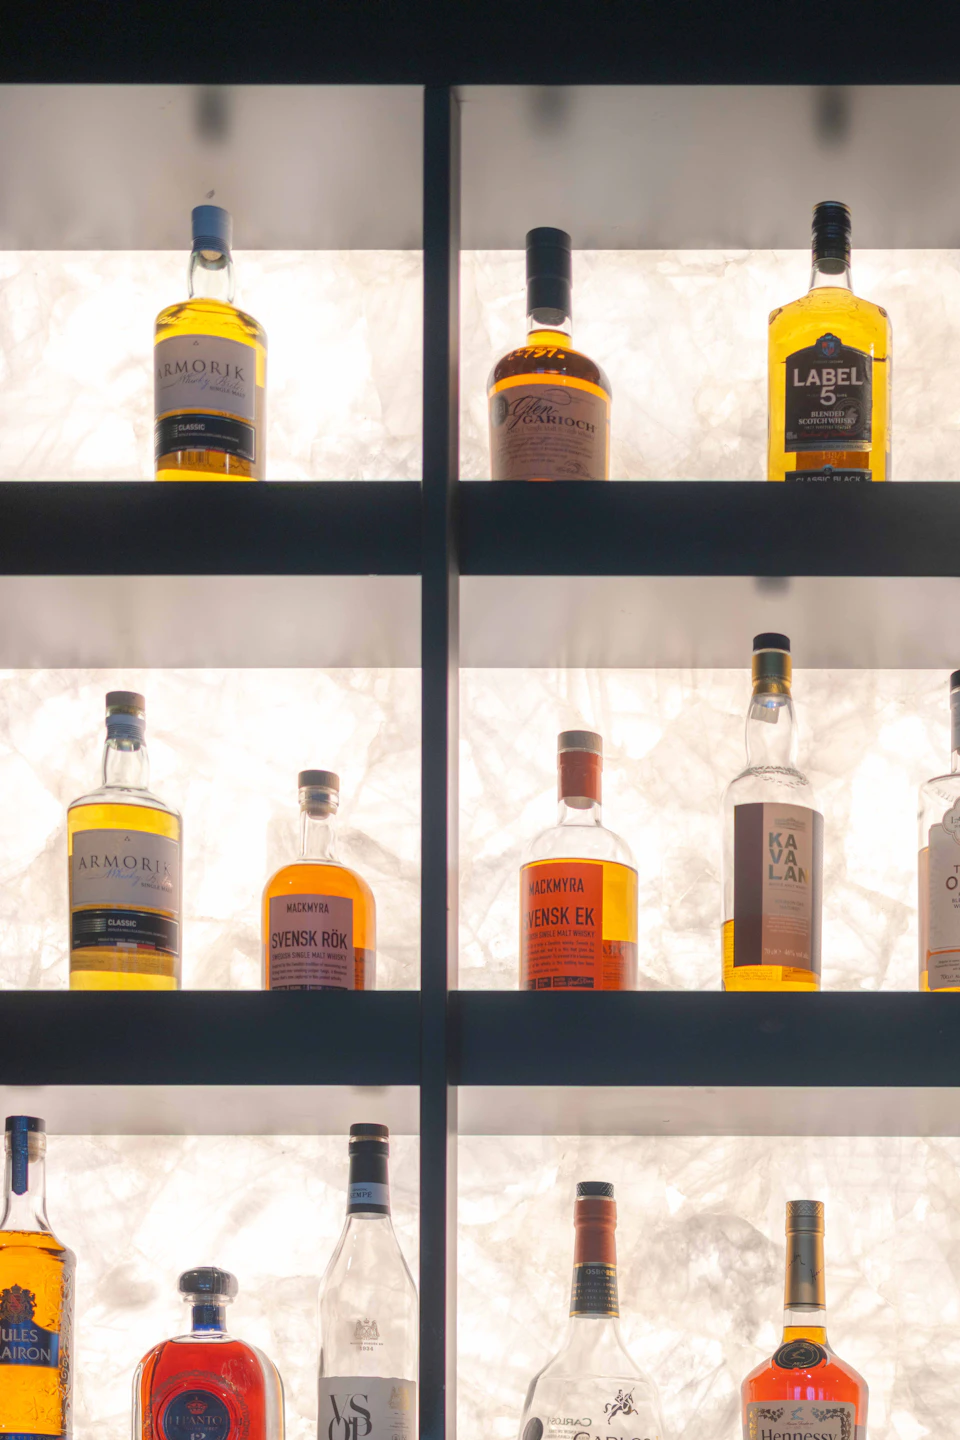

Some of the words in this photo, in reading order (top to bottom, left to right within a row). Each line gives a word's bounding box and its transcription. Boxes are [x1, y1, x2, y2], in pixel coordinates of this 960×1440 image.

[793, 367, 864, 387] LABEL
[820, 385, 836, 406] 5
[508, 395, 559, 429] Glen
[178, 423, 205, 432] CLASSIC
[523, 414, 595, 433] GARIOCH
[798, 418, 827, 426] SCOTCH
[828, 418, 857, 426] WHISKY
[768, 832, 799, 850] KA
[78, 855, 172, 874] ARMORIK
[769, 848, 799, 866] VA
[529, 878, 584, 898] MACKMYRA
[286, 902, 330, 914] MACKMYRA
[576, 907, 595, 927] EK
[108, 918, 137, 928] CLASSIC
[272, 930, 318, 950] SVENSK
[322, 929, 348, 950] RÖK
[573, 930, 594, 938] WHISKY
[272, 952, 291, 961] SWEDISH
[292, 951, 310, 960] SINGLE
[327, 952, 348, 961] WHISKY
